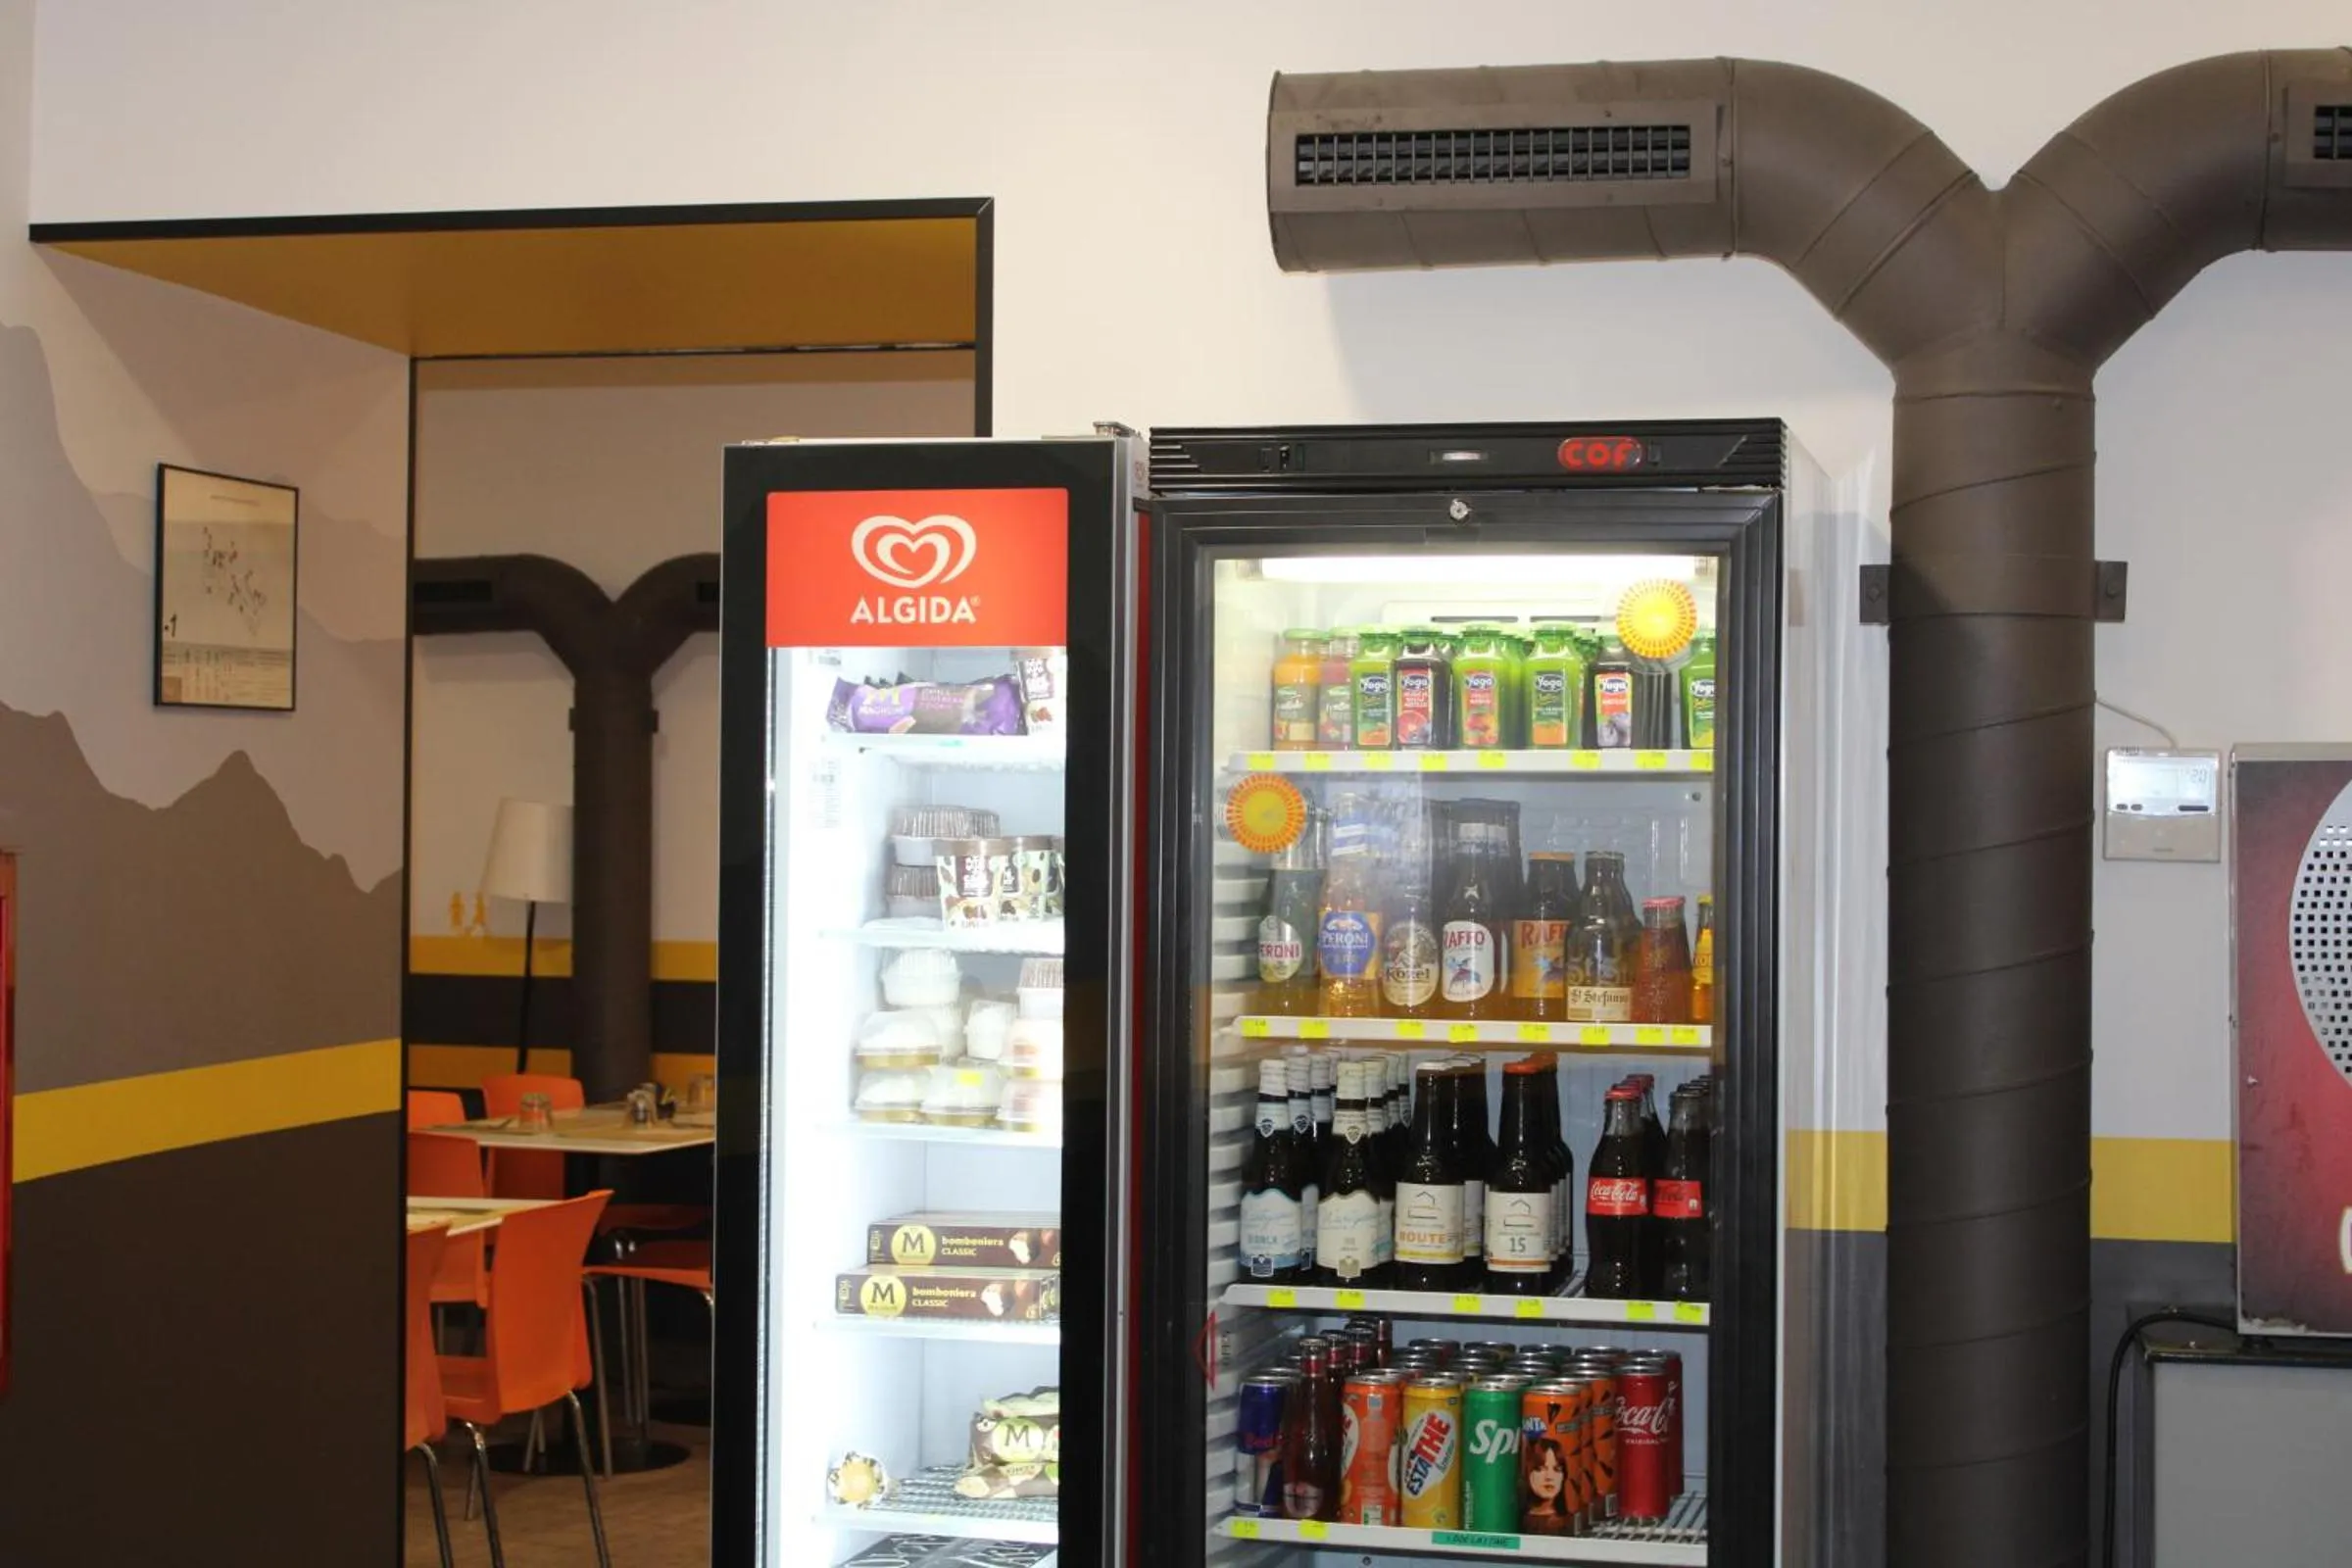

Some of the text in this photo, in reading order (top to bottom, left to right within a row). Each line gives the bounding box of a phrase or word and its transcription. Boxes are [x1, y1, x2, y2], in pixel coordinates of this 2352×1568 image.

[850, 596, 977, 624] ALGIDA
[1360, 677, 1390, 694] Yoga
[1401, 675, 1429, 690] Yoga
[1465, 676, 1494, 690] Yoga
[1536, 677, 1564, 692] Yoga
[1601, 679, 1628, 693] Yoga
[1320, 931, 1369, 947] PERONI
[1260, 944, 1300, 959] ERONI
[902, 1232, 924, 1253] M
[1510, 1237, 1526, 1252] 15
[941, 1248, 978, 1256] CLASSIC
[871, 1282, 895, 1304] M
[911, 1298, 949, 1307] CLASSIC
[1004, 1424, 1031, 1447] M
